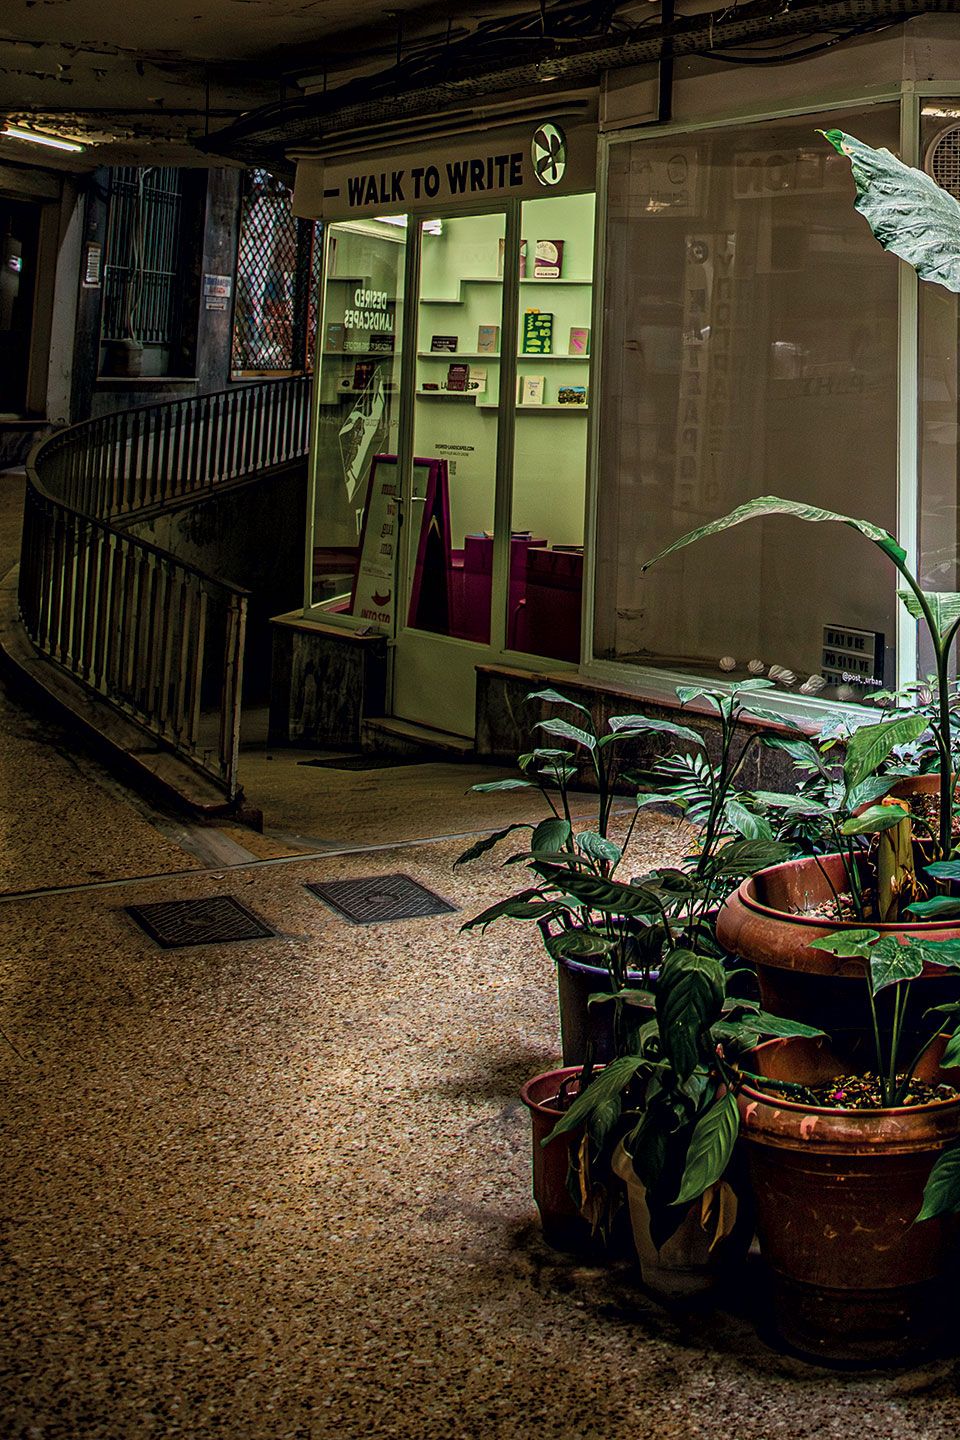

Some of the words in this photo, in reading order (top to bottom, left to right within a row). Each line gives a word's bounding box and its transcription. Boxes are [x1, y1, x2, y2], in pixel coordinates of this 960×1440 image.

[348, 170, 405, 207] WALK
[411, 165, 440, 199] TO
[446, 152, 524, 194] WRITE
[828, 632, 865, 650] NATURE
[825, 652, 869, 673] POSITIVE
